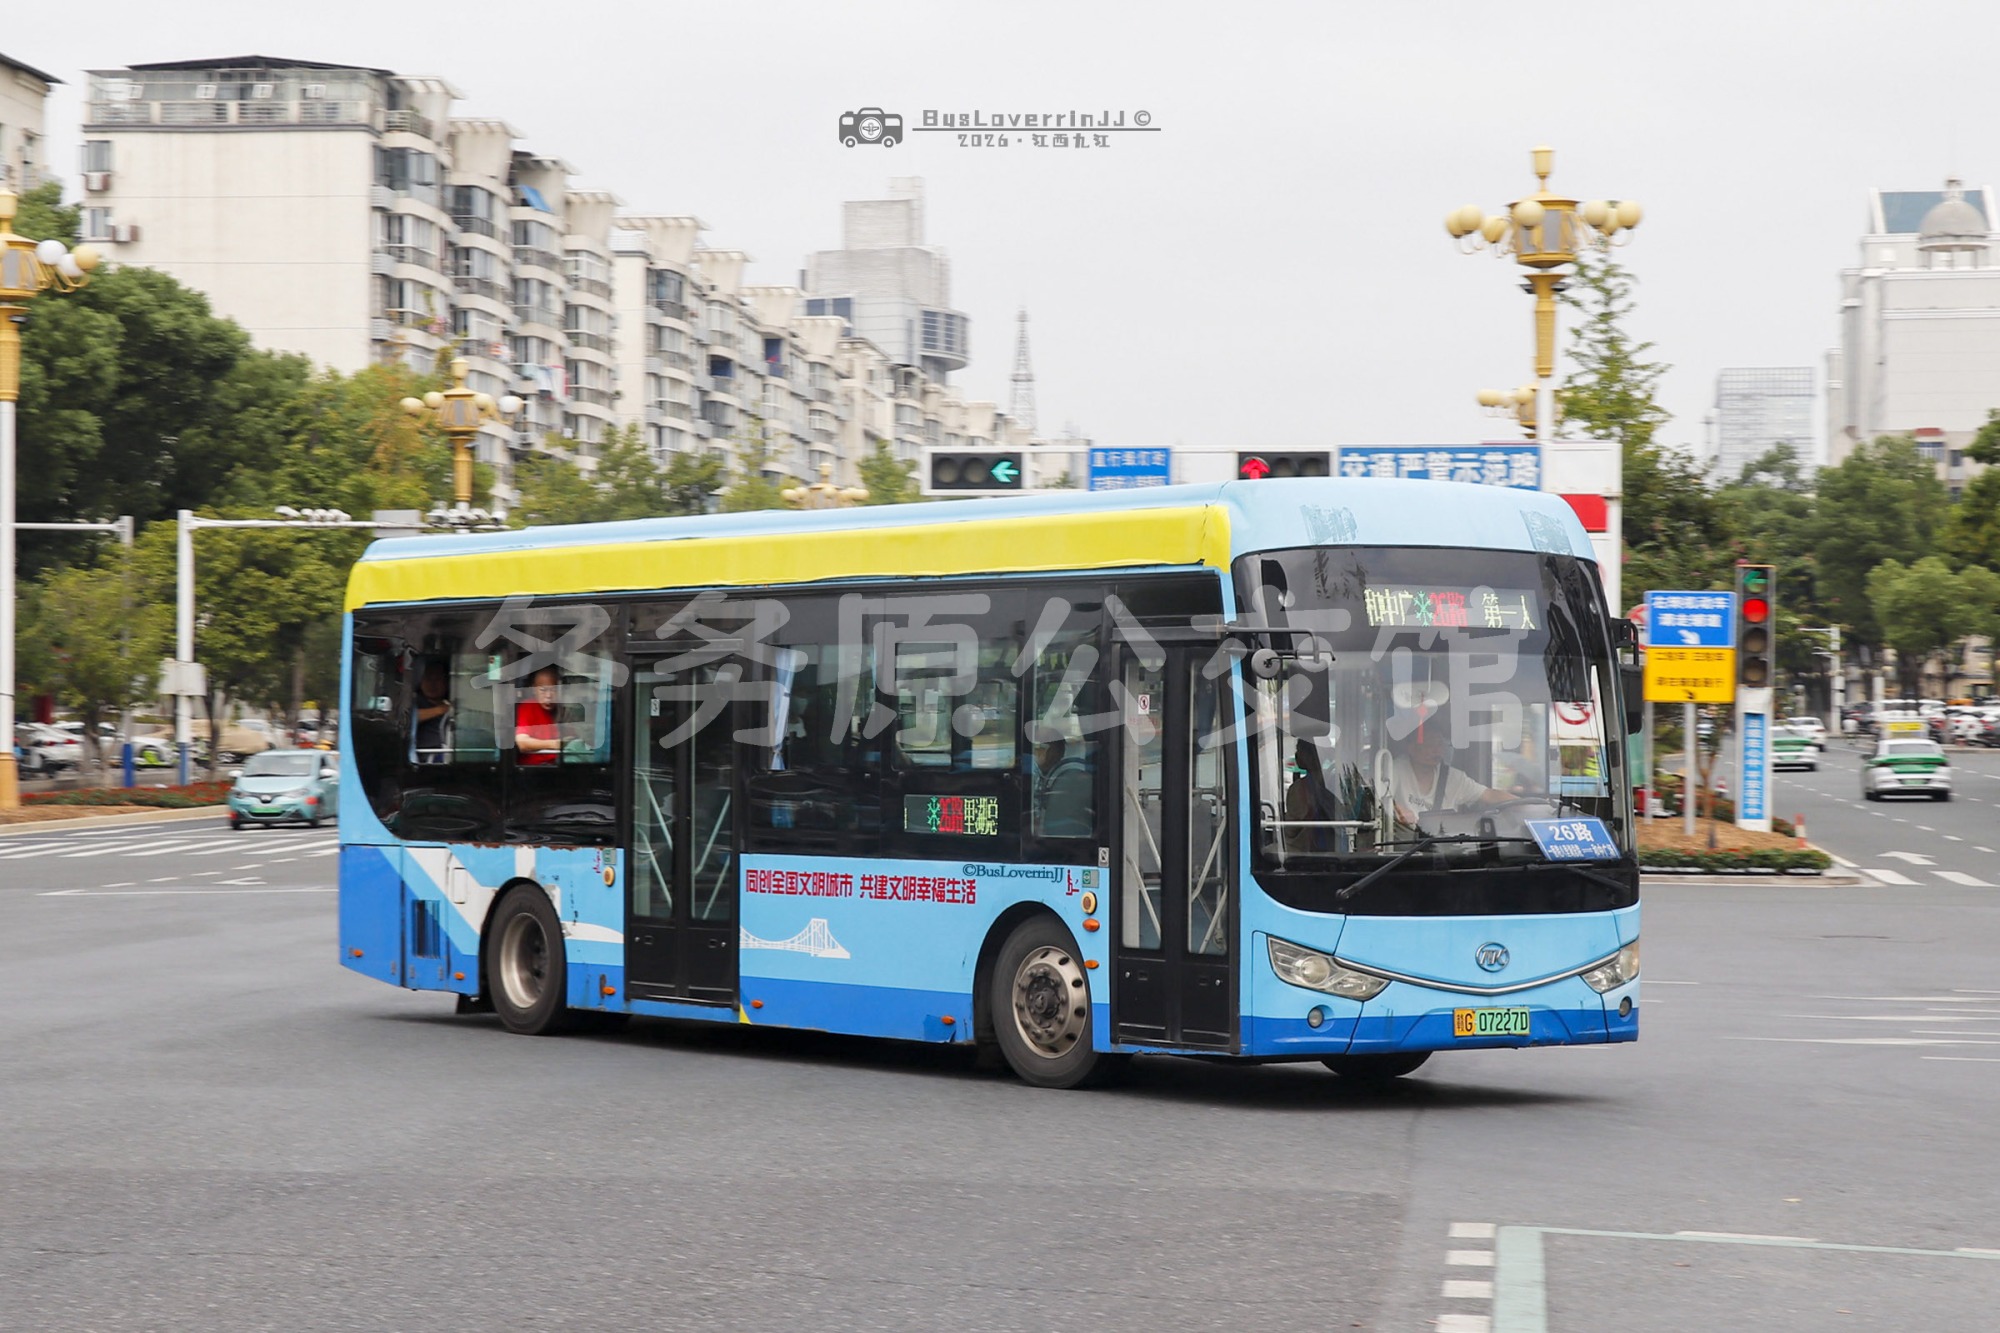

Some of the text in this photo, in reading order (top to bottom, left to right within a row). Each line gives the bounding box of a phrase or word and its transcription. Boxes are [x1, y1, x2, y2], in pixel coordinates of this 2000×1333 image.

[1481, 593, 1536, 630] 第一人
[1548, 822, 1595, 842] 26路
[745, 868, 977, 904] 同创全国文明城市 共建文明幸福生活
